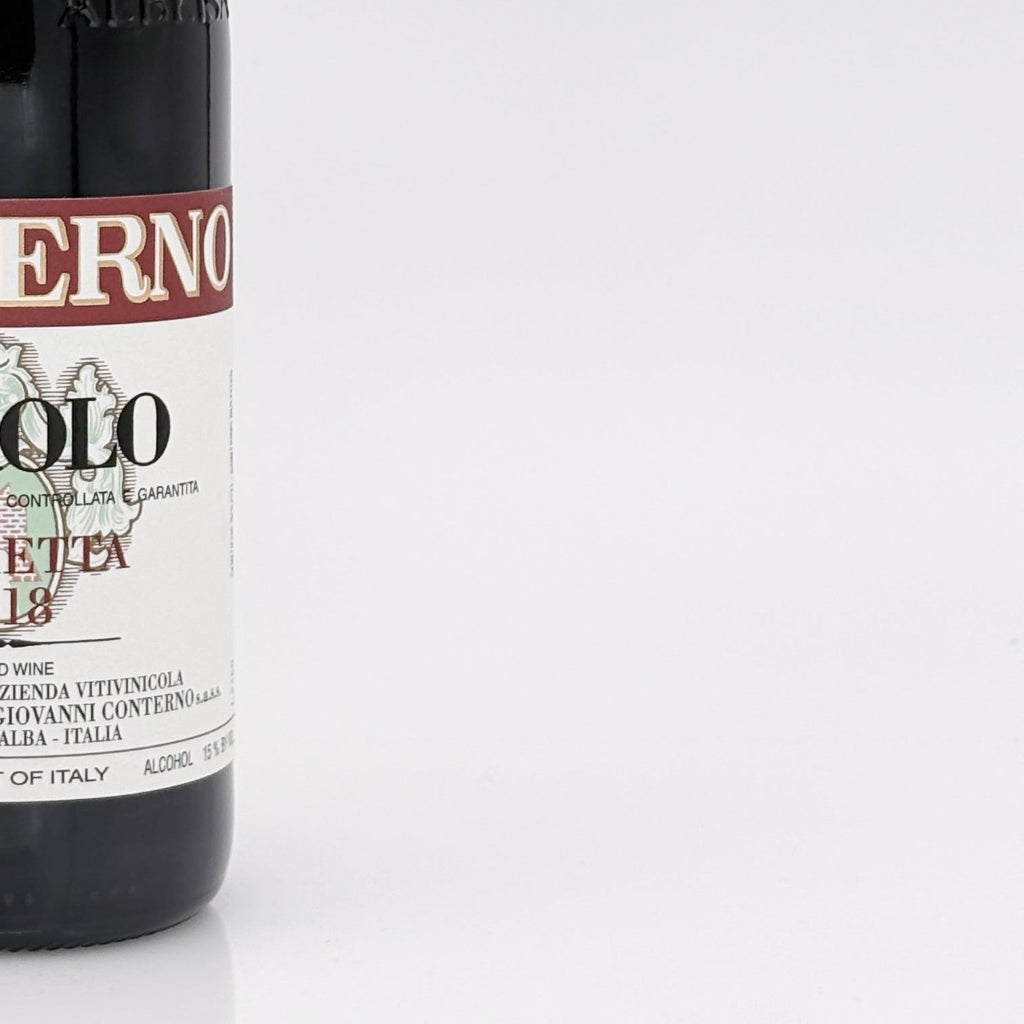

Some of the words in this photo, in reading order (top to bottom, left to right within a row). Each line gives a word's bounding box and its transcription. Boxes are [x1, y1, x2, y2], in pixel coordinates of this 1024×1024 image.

[6, 491, 115, 508] CONTROLLATA
[137, 480, 200, 502] GARANTITA
[13, 661, 54, 676] WINE
[75, 669, 184, 698] VITIVINICOLA
[102, 688, 194, 721] CONTERNO
[64, 724, 122, 745] ITALIA
[144, 750, 193, 775] ALCOHOL
[10, 770, 43, 785] OF
[50, 767, 110, 784] ITALY
